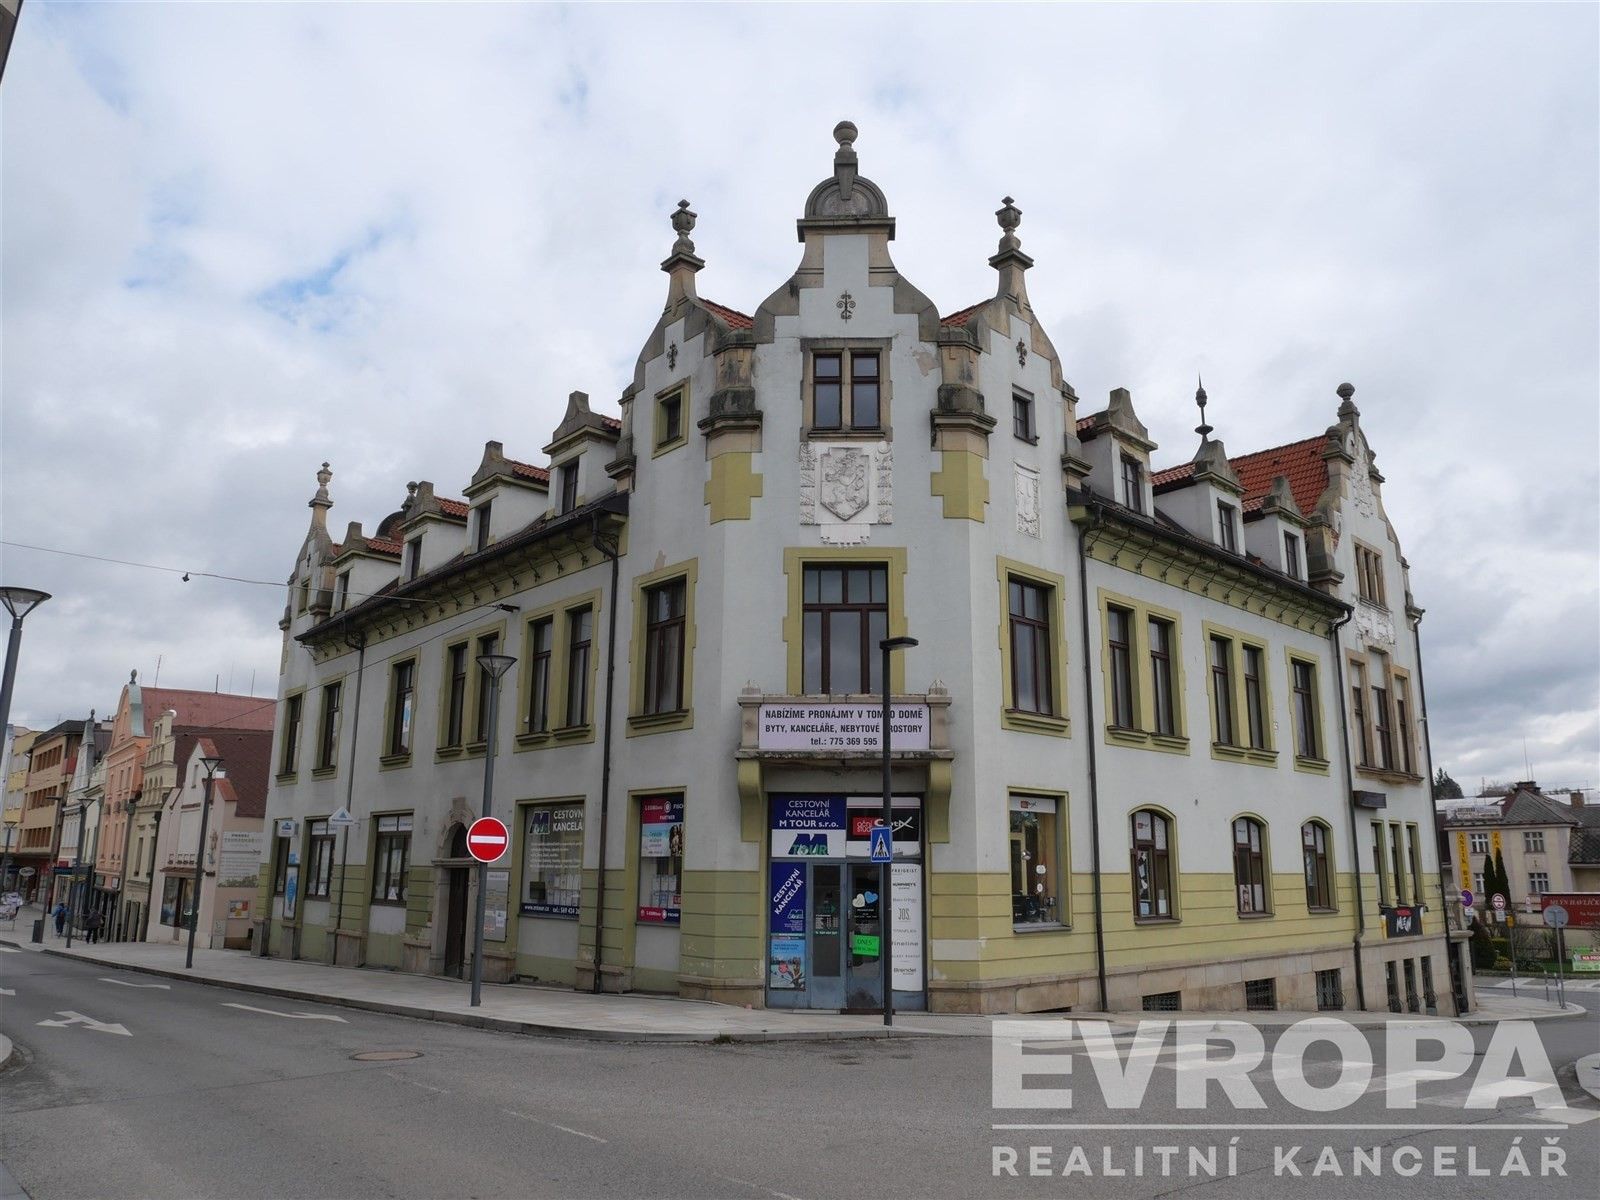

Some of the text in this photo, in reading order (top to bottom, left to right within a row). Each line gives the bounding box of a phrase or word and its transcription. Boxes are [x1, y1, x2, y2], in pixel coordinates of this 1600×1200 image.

[765, 707, 923, 719] NABÍZÍME PRONÁJMY V TOMO DOMĚ
[765, 722, 923, 733] BYTY, KANCELÁŘE, NEBYTOVÉ ROSTORY
[810, 737, 878, 746] tel.: 775 369 595
[788, 799, 830, 808] CESTOVNÍ
[785, 808, 831, 818] KANCELÁŘ
[779, 819, 839, 828] M TOUR s.r.o.
